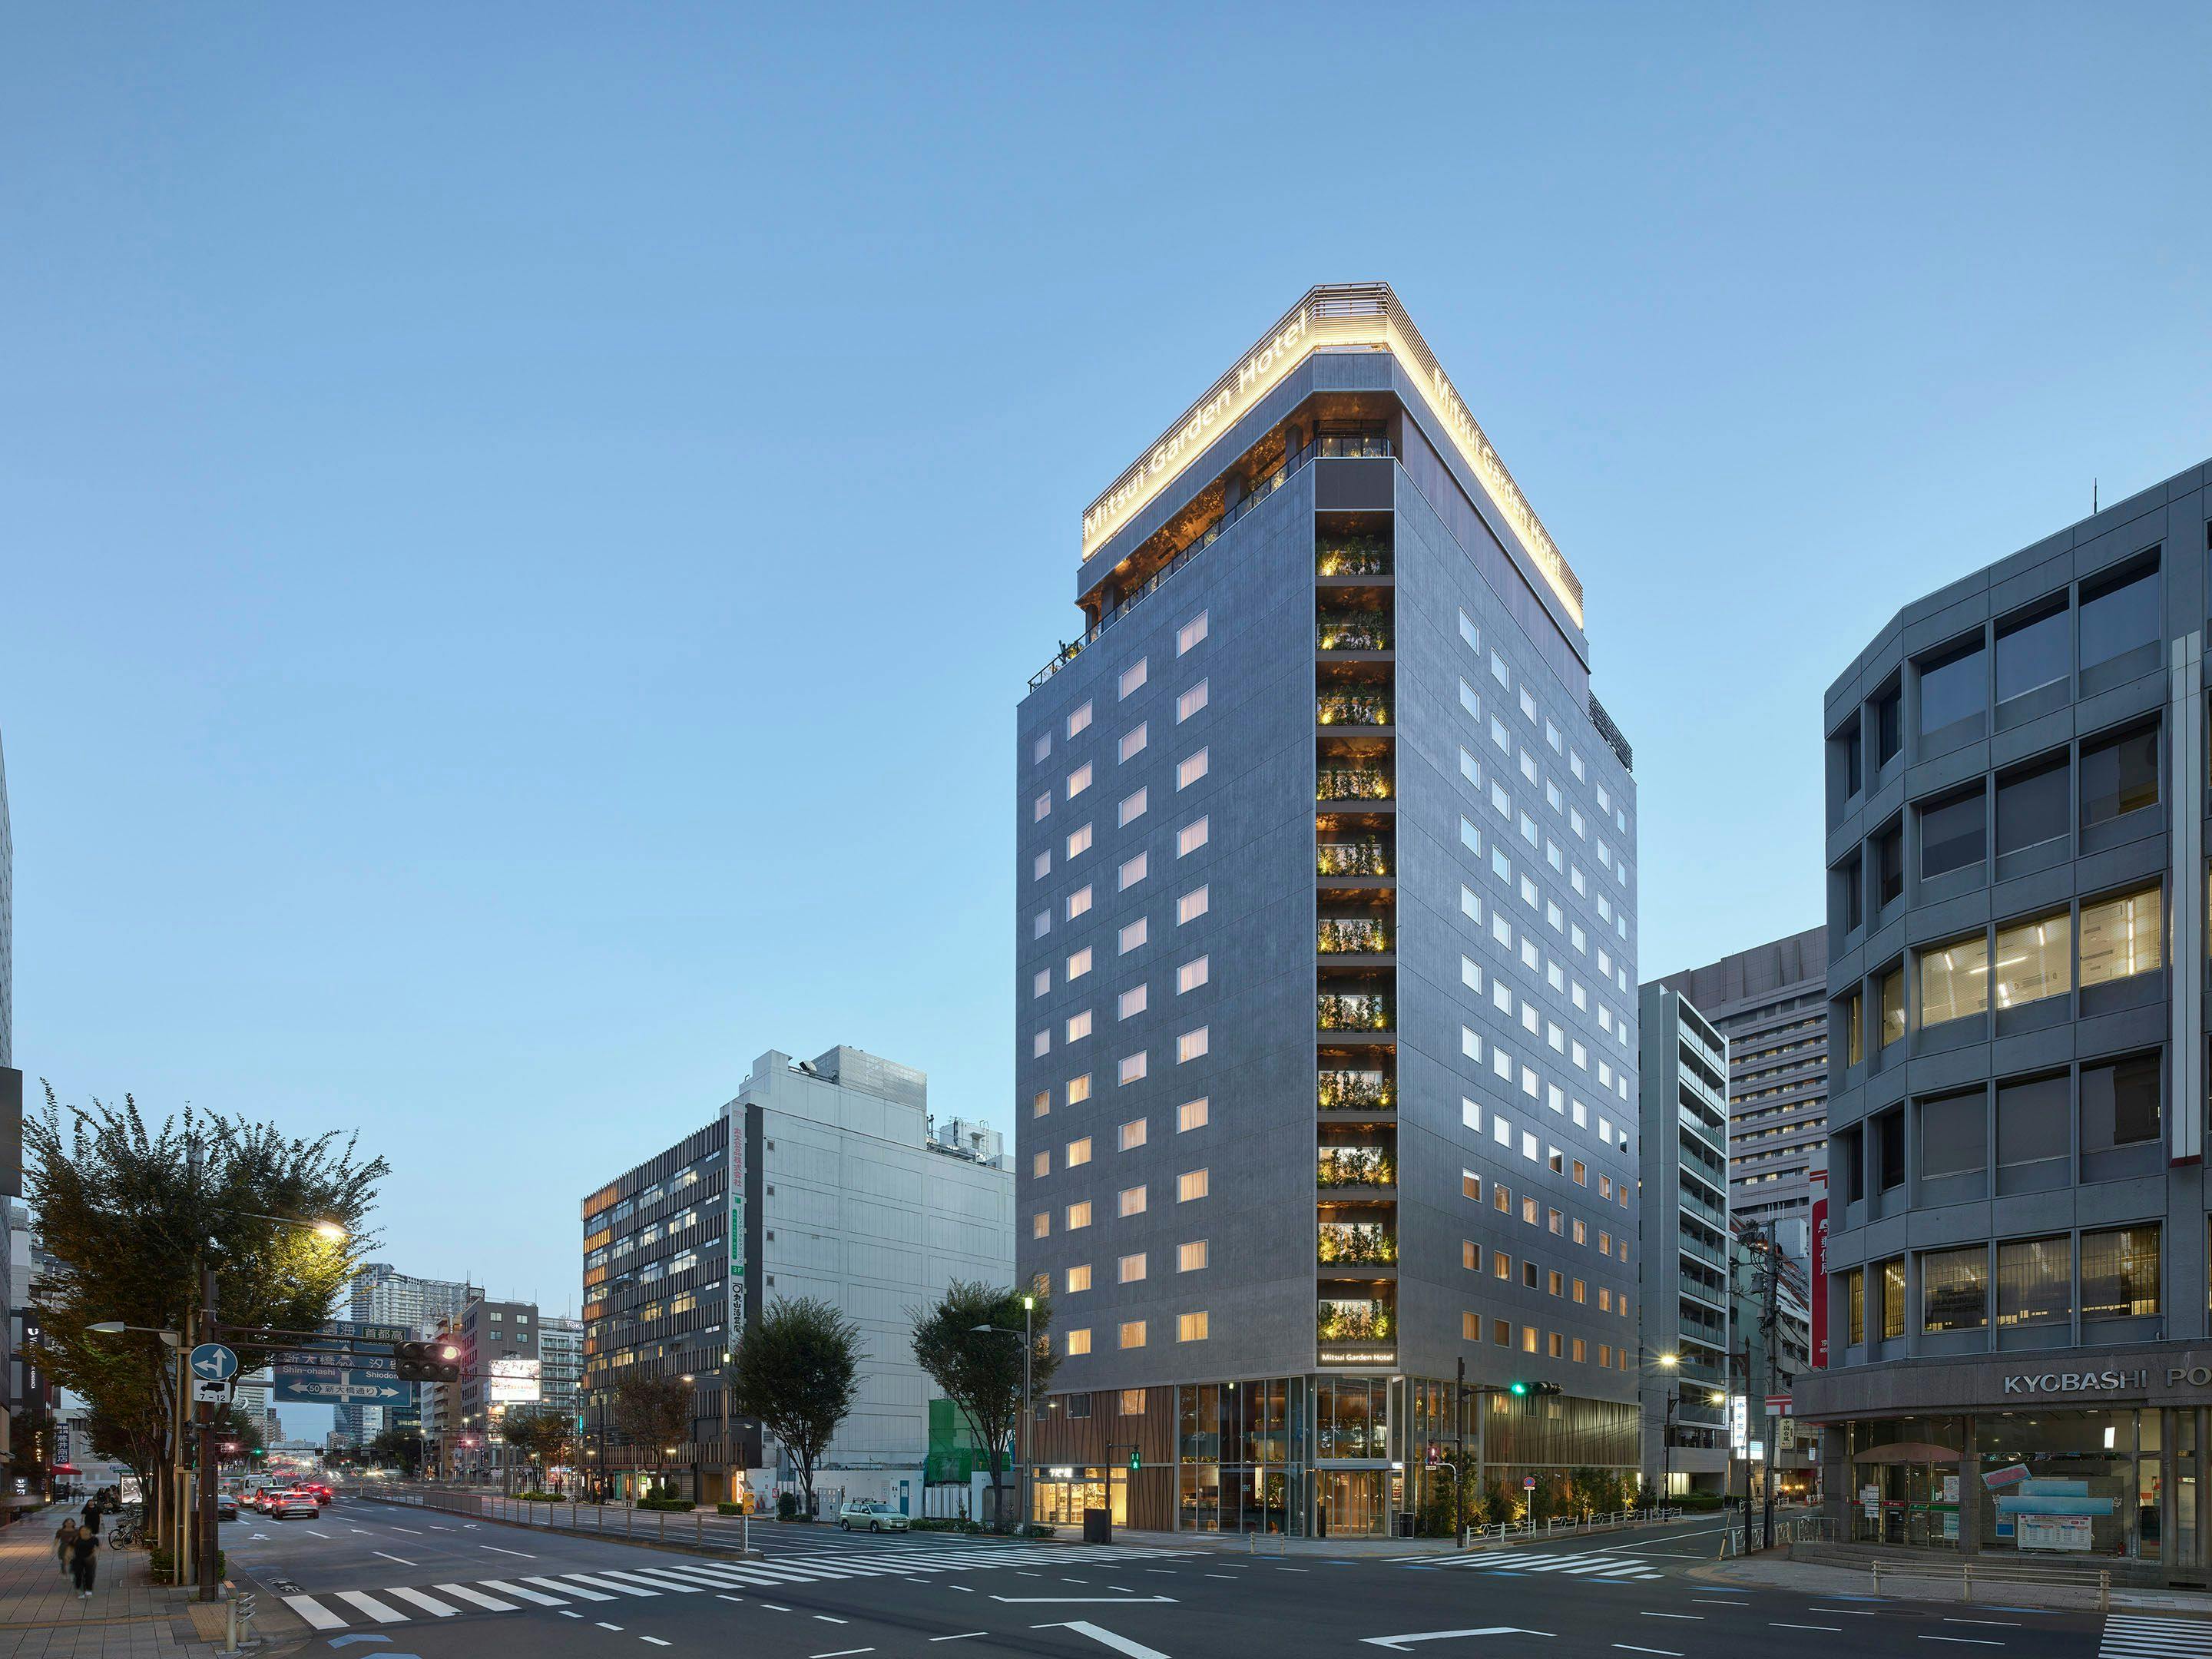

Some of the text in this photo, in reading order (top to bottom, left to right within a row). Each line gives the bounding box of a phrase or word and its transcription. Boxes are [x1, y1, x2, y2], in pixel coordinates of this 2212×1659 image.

[1084, 308, 1307, 539] Mitsui Garden Hotel
[1434, 367, 1561, 576] Mitsui Garden Hotel
[365, 1328, 403, 1340] 首都高
[283, 1353, 335, 1366] 新大橋
[283, 1366, 336, 1376] Shin-ohashi
[2005, 1369, 2147, 1394] KYOBASHI
[325, 1385, 374, 1395] 新大橋通り
